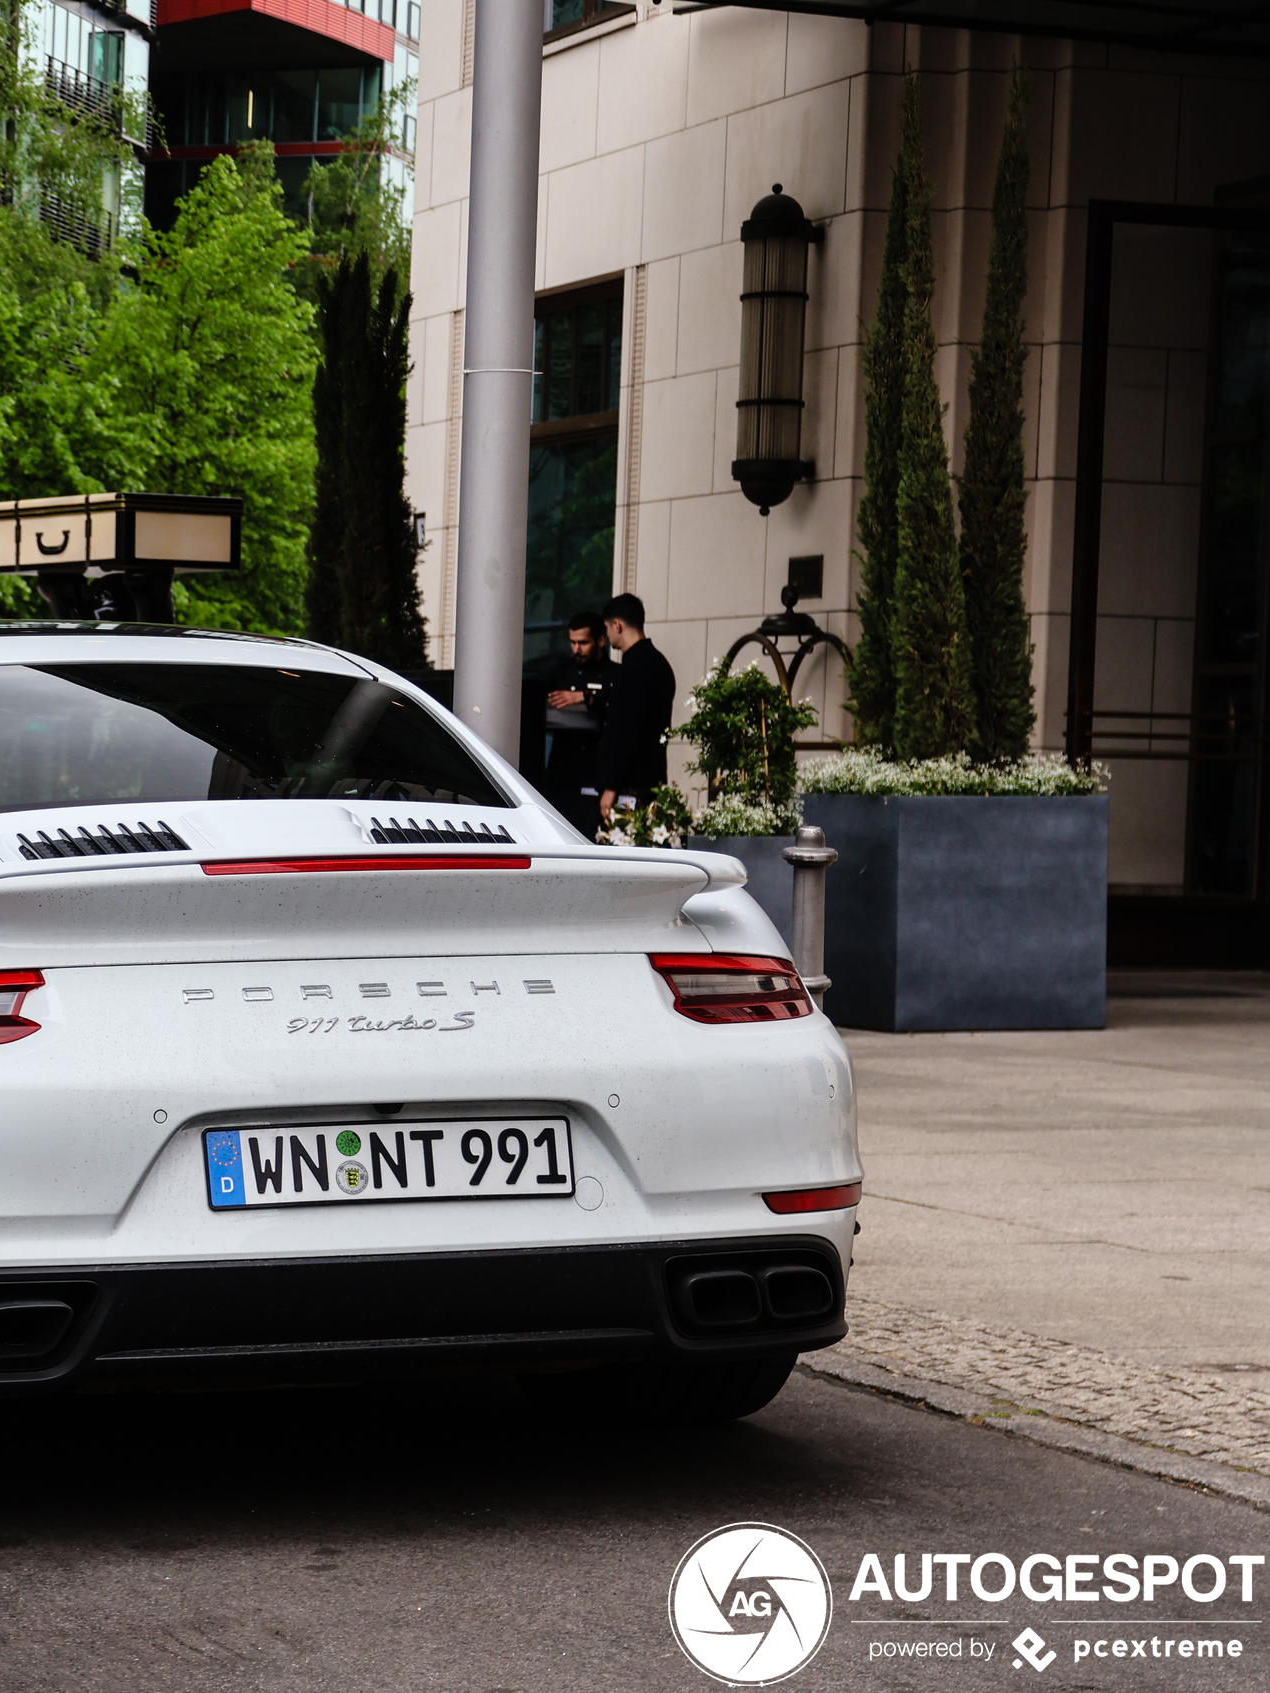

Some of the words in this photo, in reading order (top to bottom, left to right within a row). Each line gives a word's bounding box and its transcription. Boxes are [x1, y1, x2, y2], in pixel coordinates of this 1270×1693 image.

[182, 979, 556, 1003] PORSCHE
[286, 1016, 340, 1034] 911
[347, 1013, 438, 1032] turbo
[438, 1010, 476, 1031] S
[248, 1134, 329, 1195] WN
[369, 1129, 445, 1189] NT
[460, 1127, 567, 1187] 991
[220, 1176, 235, 1194] D
